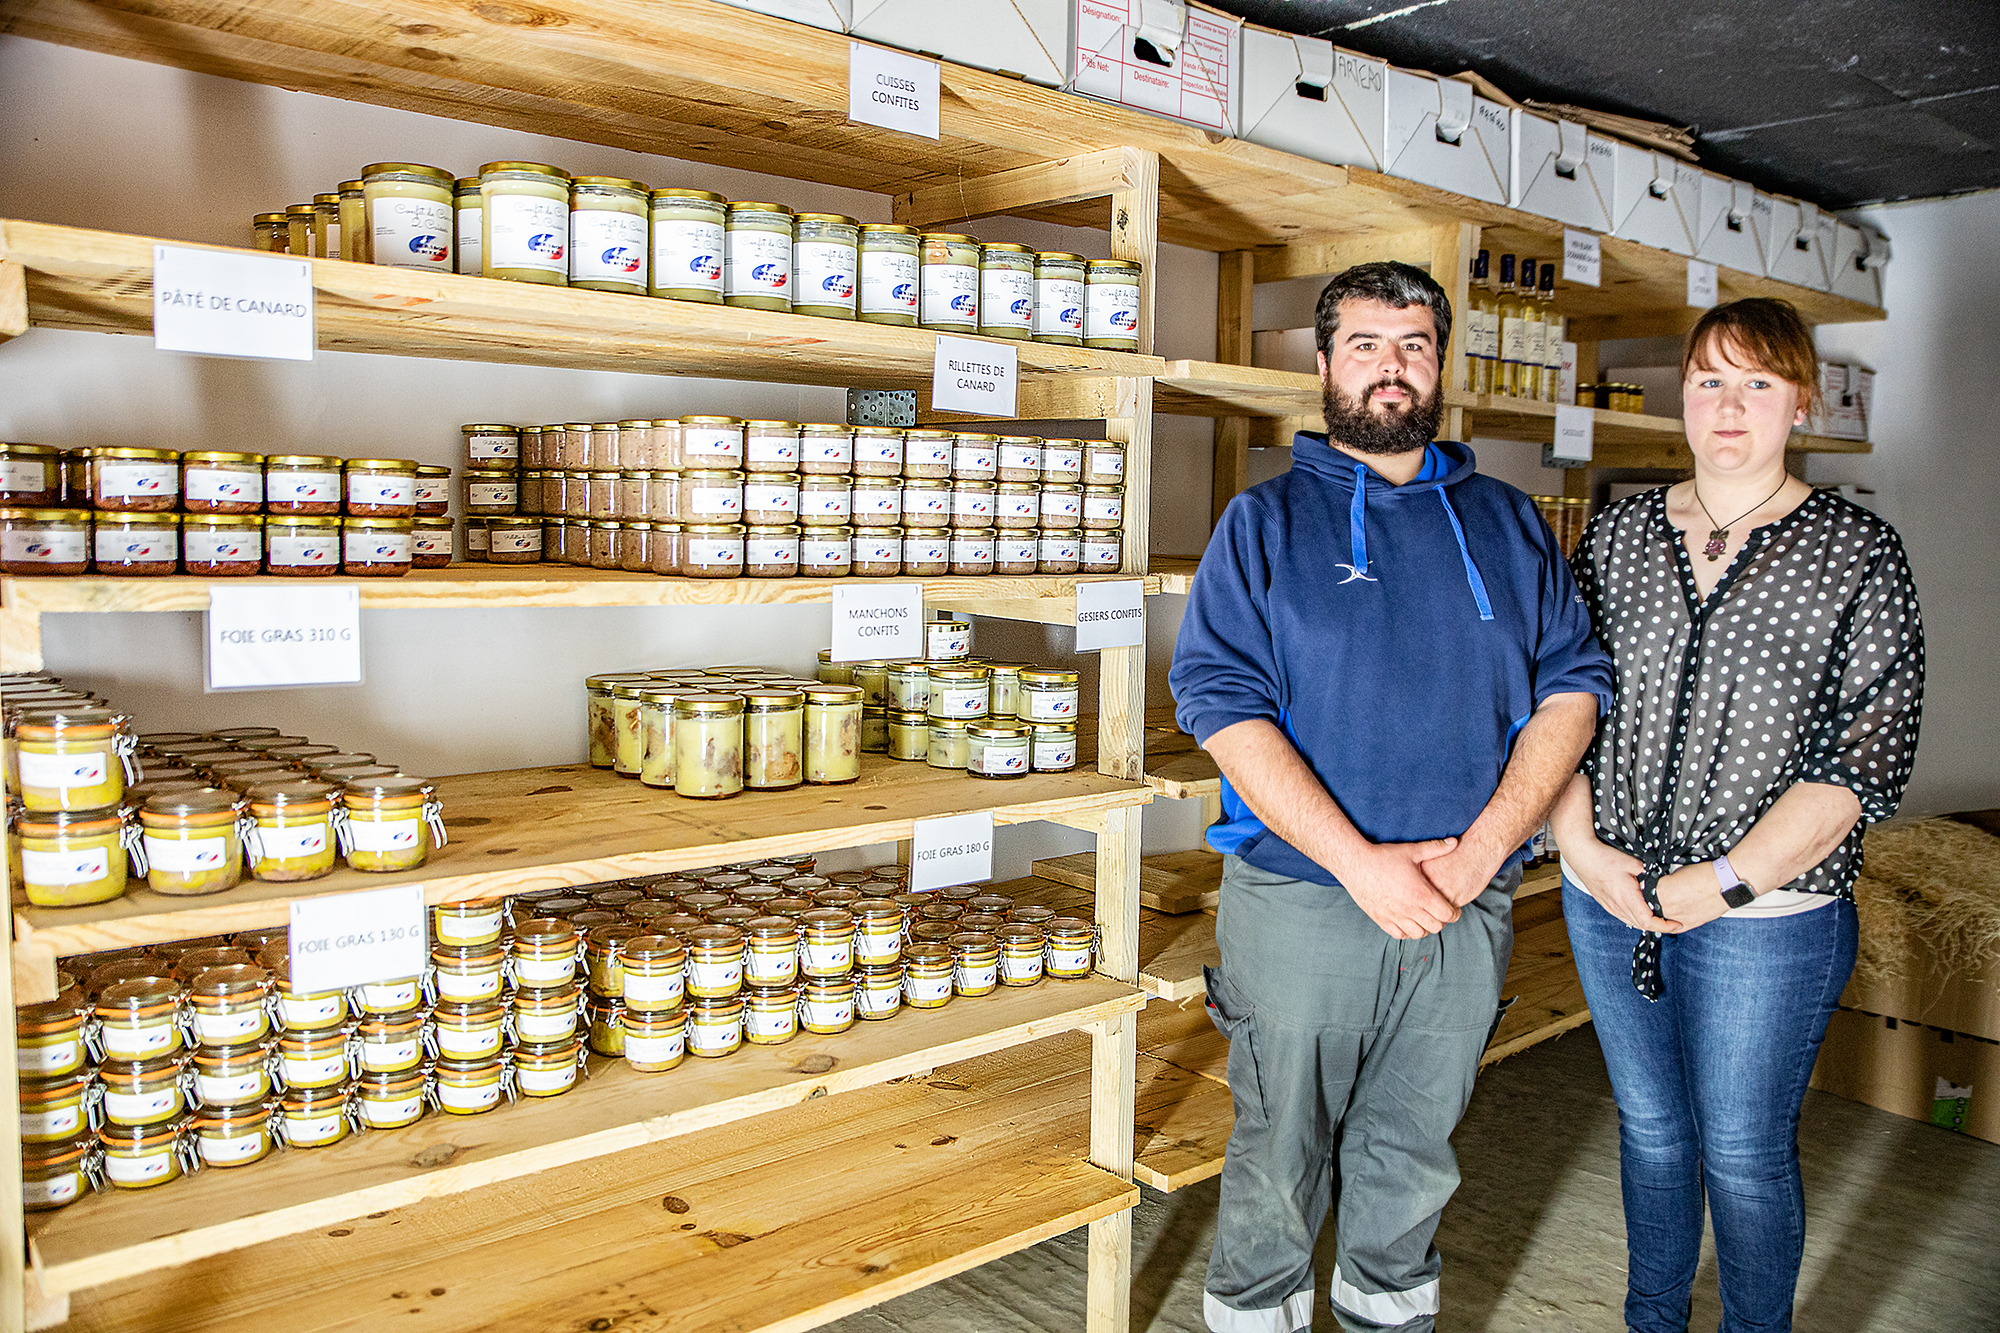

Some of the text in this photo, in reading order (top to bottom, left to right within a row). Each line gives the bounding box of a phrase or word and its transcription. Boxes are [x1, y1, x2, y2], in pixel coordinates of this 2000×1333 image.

[1082, 5, 1122, 22] Désignation:
[876, 74, 916, 92] CUISSES
[1134, 71, 1169, 88] Destinataire:
[872, 90, 920, 110] CONFITES
[162, 288, 307, 318] PÂTÉ DE CANARD
[948, 360, 1004, 377] RILLETTES DE
[957, 378, 995, 392] CANARD
[849, 607, 908, 620] MANCHONS
[1078, 607, 1142, 622] GESIERS CONFITS
[220, 628, 351, 644] FOIE GRAS 310 G
[858, 625, 900, 637] CONFITS
[918, 840, 990, 861] FOIE GRAS 180 G
[298, 924, 420, 954] FOIE GRAS 130 G
